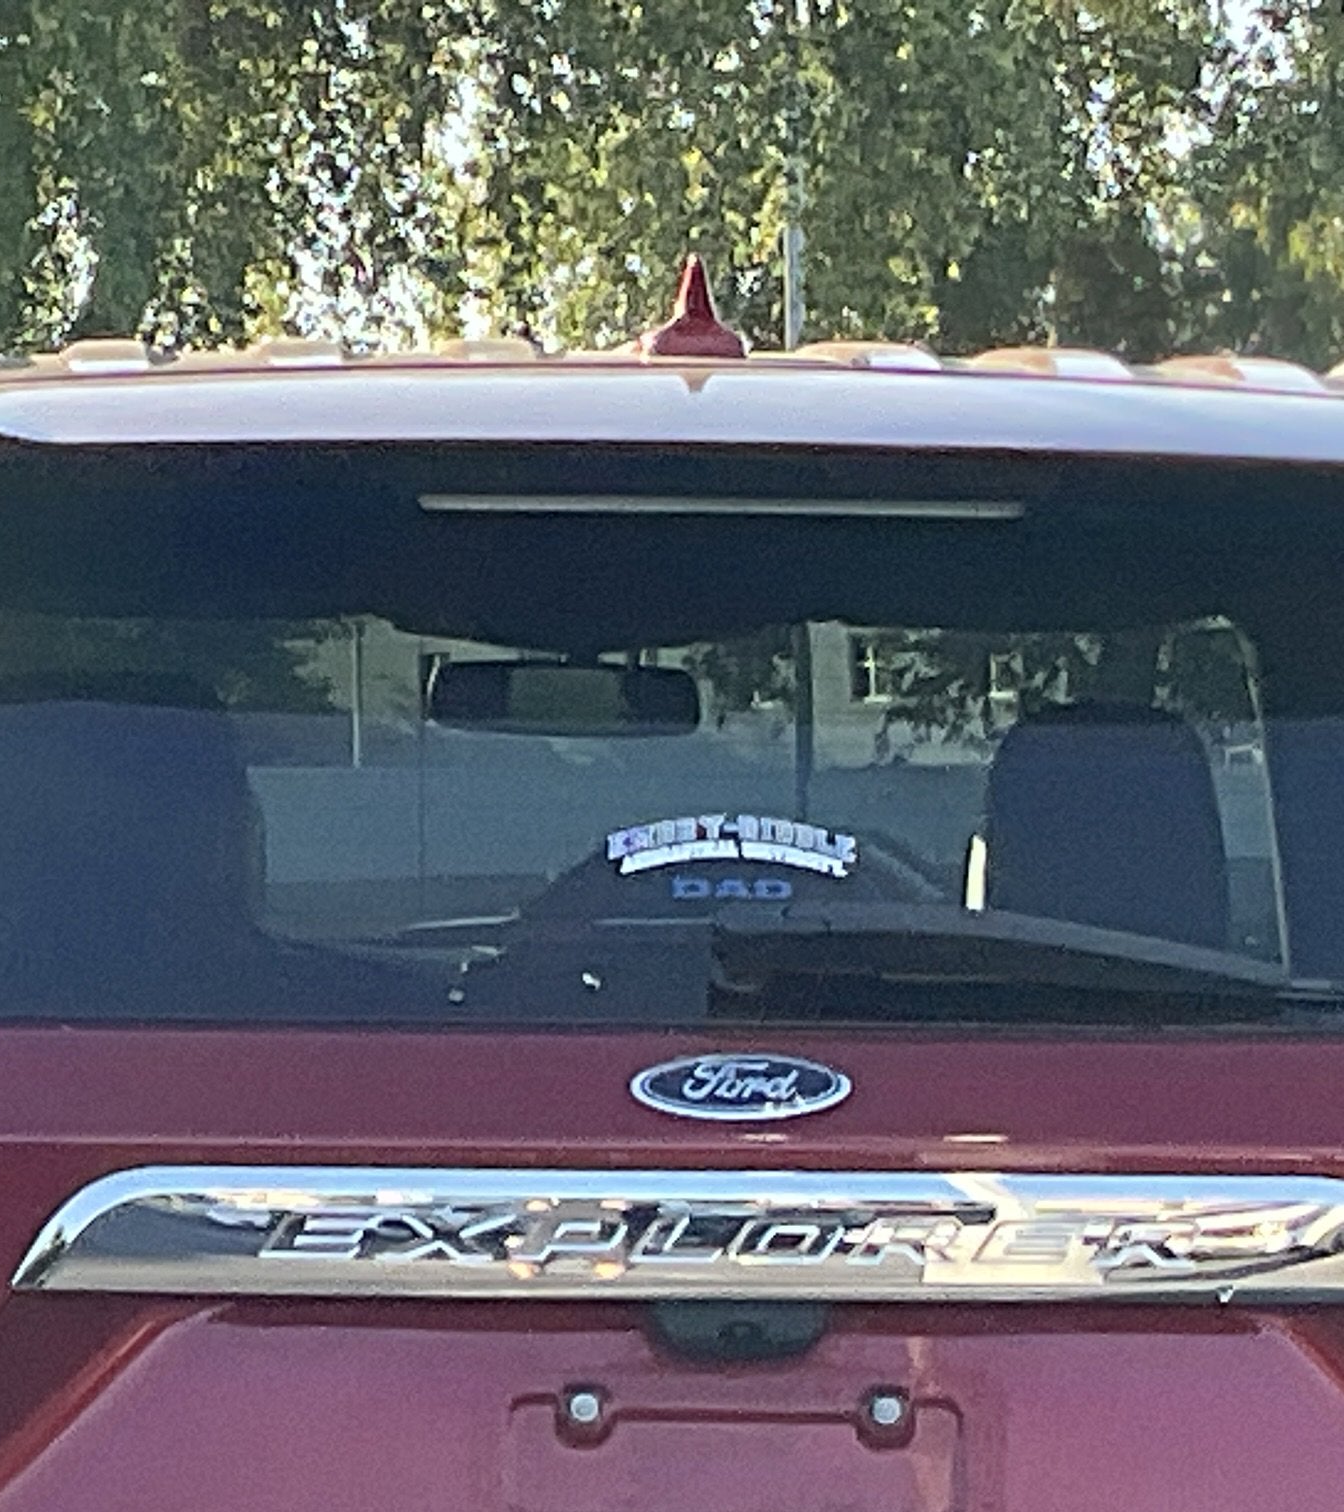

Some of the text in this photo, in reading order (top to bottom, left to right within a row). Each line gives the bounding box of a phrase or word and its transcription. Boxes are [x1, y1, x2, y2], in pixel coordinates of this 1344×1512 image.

[672, 877, 793, 899] DAD
[682, 1062, 800, 1101] Ford
[258, 1206, 1202, 1270] EXPLORER
